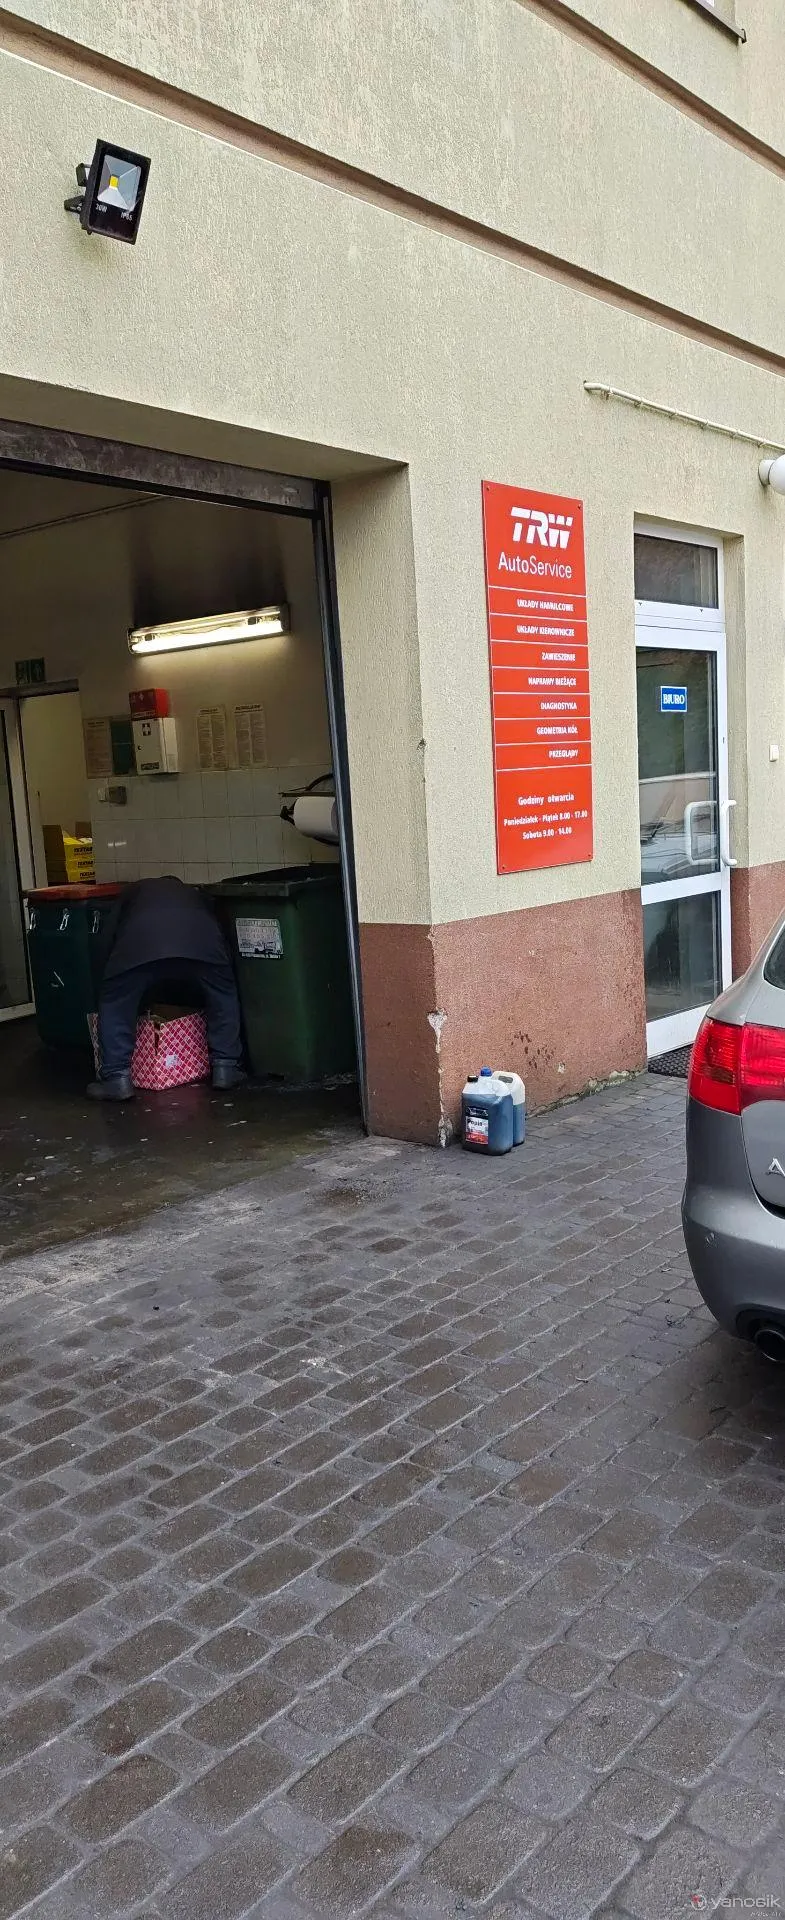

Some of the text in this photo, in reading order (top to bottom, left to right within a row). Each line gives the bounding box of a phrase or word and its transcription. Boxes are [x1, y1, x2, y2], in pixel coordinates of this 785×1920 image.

[511, 506, 573, 550] TRW
[498, 551, 572, 579] AutoService
[528, 677, 555, 686] NAPRAWY
[662, 693, 685, 705] BIURO
[540, 702, 577, 711] DIAGNOSTYKA
[536, 725, 578, 735] GEOMETRIA KÓŁ
[518, 792, 575, 806] Godziny otwarcia
[503, 815, 538, 827] Poniedziałek
[542, 813, 559, 823] Piątek
[522, 831, 543, 840] Sobota
